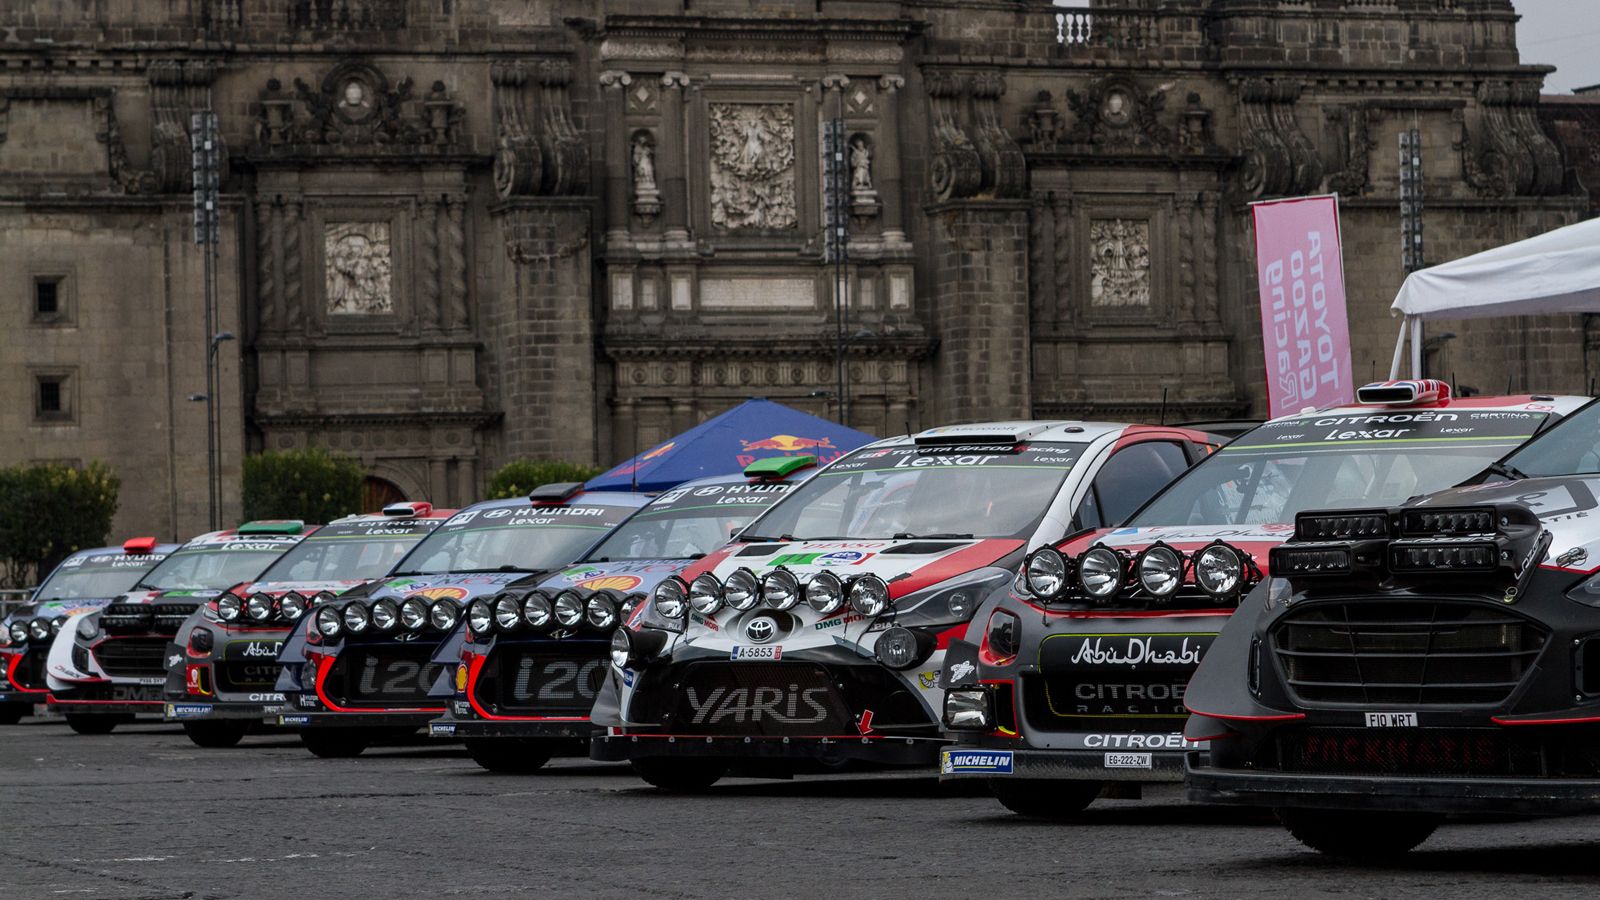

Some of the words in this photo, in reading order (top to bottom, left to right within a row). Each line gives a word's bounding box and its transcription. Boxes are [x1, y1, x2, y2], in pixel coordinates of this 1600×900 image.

[1324, 428, 1409, 440] Lexar
[894, 455, 1000, 468] Lexar
[1033, 455, 1074, 463] Lexar
[716, 496, 769, 505] Lexar
[515, 508, 606, 516] HYUNDAI
[508, 517, 556, 526] Lexar
[221, 542, 280, 551] Lexar
[815, 619, 842, 631] DMG
[1370, 714, 1387, 728] F10
[1390, 714, 1412, 728] WRT
[953, 755, 1011, 767] MICHELIN
[1109, 755, 1149, 765] EG-222-ZW
